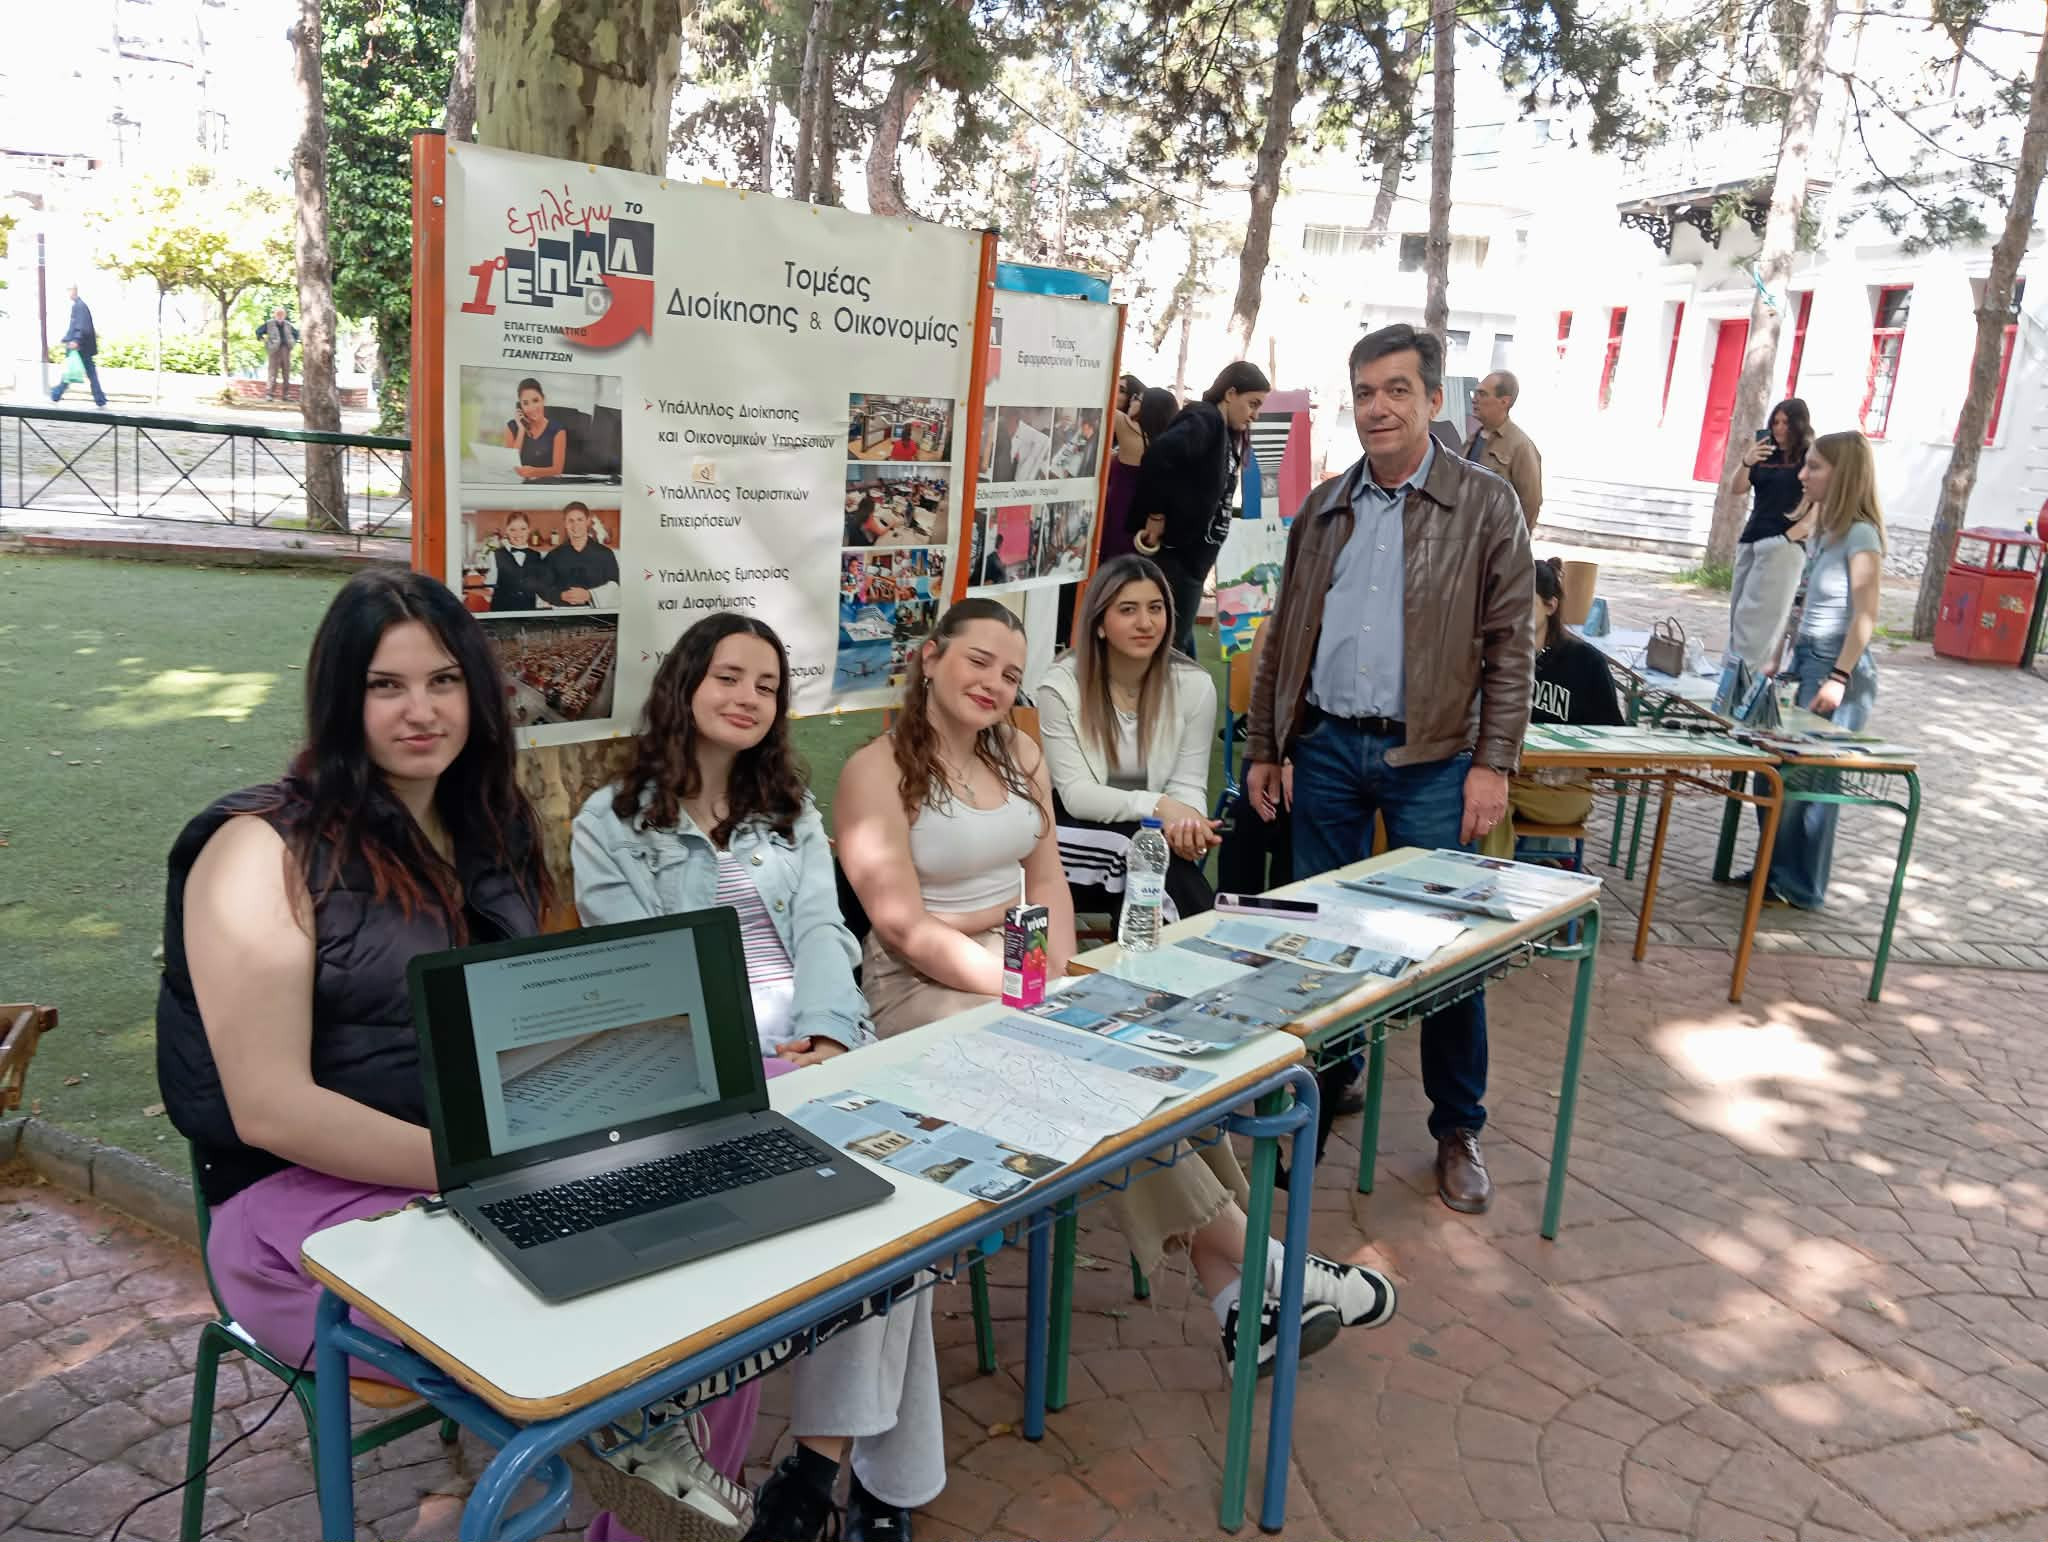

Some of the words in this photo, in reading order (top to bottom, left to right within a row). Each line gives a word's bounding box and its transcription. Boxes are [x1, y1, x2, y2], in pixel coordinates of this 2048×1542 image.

[507, 184, 612, 247] επιλέγω
[624, 201, 643, 215] ΤΟ
[784, 260, 871, 302] Τομέας
[666, 287, 799, 333] Διοίκησης
[809, 311, 822, 331] &
[833, 306, 960, 348] Οικονομίας
[503, 333, 544, 345] ΛΥΚΕΙΟ
[502, 348, 574, 363] ΓΙΑΝΝΙΤΣΩΝ
[658, 399, 735, 420] Υπάλληλος
[738, 404, 800, 423] Διοίκησης
[658, 431, 679, 444] και
[683, 429, 768, 448] Οικονομικών
[659, 485, 731, 503] Υπάλληλος
[735, 486, 810, 502] Τουριστικών
[660, 513, 742, 530] Επιχειρήσεων
[658, 568, 731, 583] Υπάλληλος
[734, 565, 790, 583] Εμπορίας
[657, 599, 678, 610] και
[682, 595, 757, 610] Διαφήμισης
